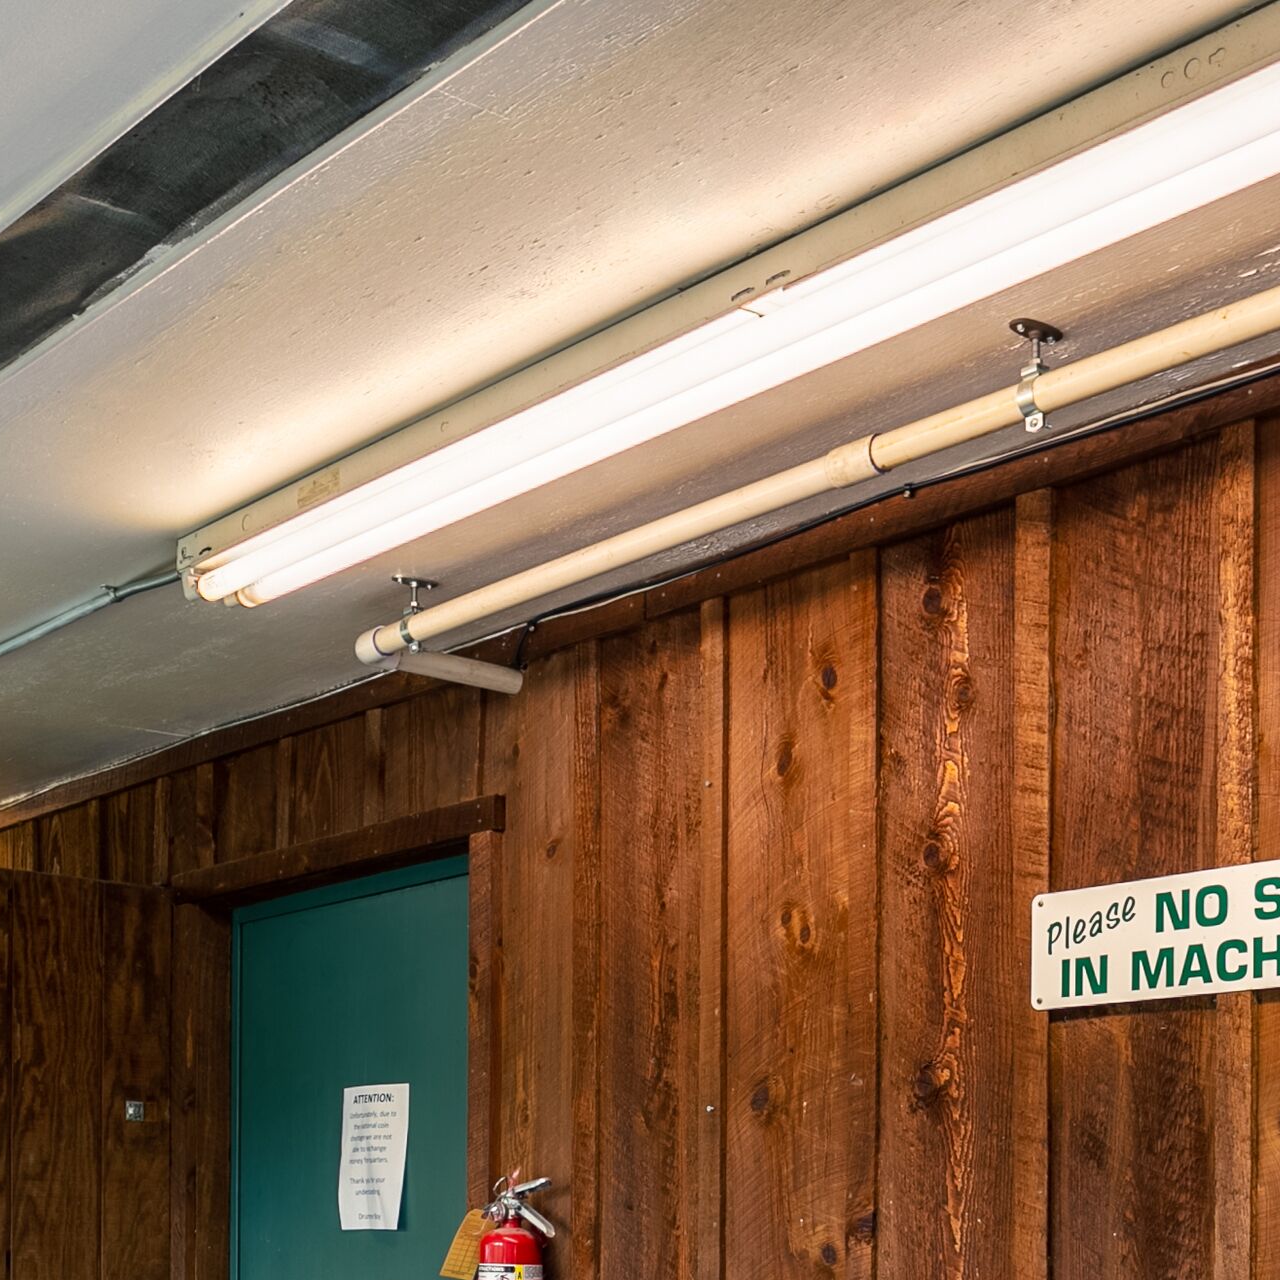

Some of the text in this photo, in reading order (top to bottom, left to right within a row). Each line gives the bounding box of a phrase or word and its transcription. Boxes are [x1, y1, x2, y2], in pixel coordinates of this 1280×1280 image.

[1046, 896, 1136, 955] Please
[1155, 884, 1229, 933] NO
[1060, 954, 1109, 998] IN
[353, 1093, 394, 1105] ATTENTION:
